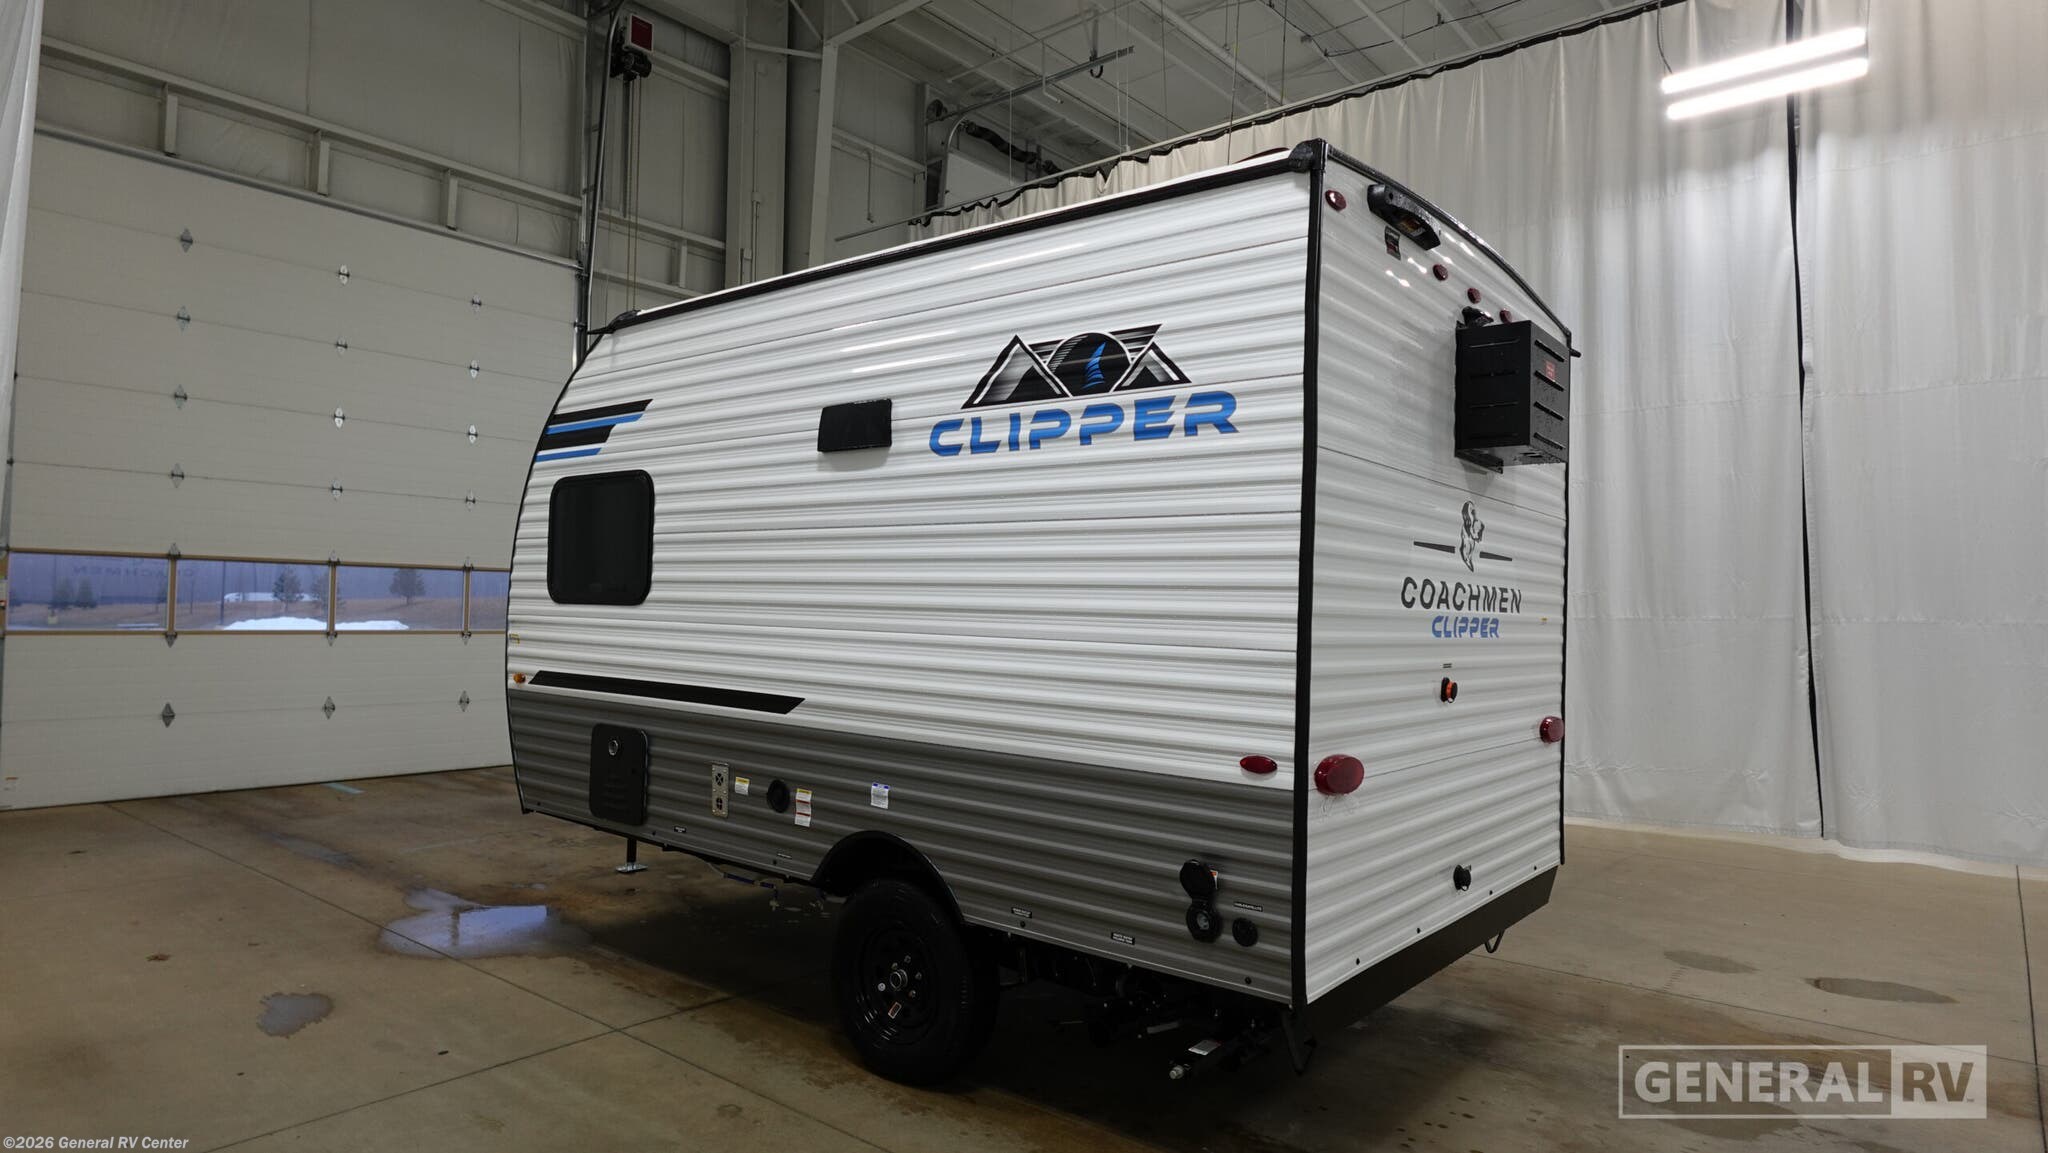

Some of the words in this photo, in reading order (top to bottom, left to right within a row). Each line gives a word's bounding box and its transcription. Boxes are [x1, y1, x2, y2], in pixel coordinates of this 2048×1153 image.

[929, 390, 1239, 457] CLIPPER
[1401, 576, 1522, 614] COACHMEN
[1431, 615, 1500, 639] CLIPPER
